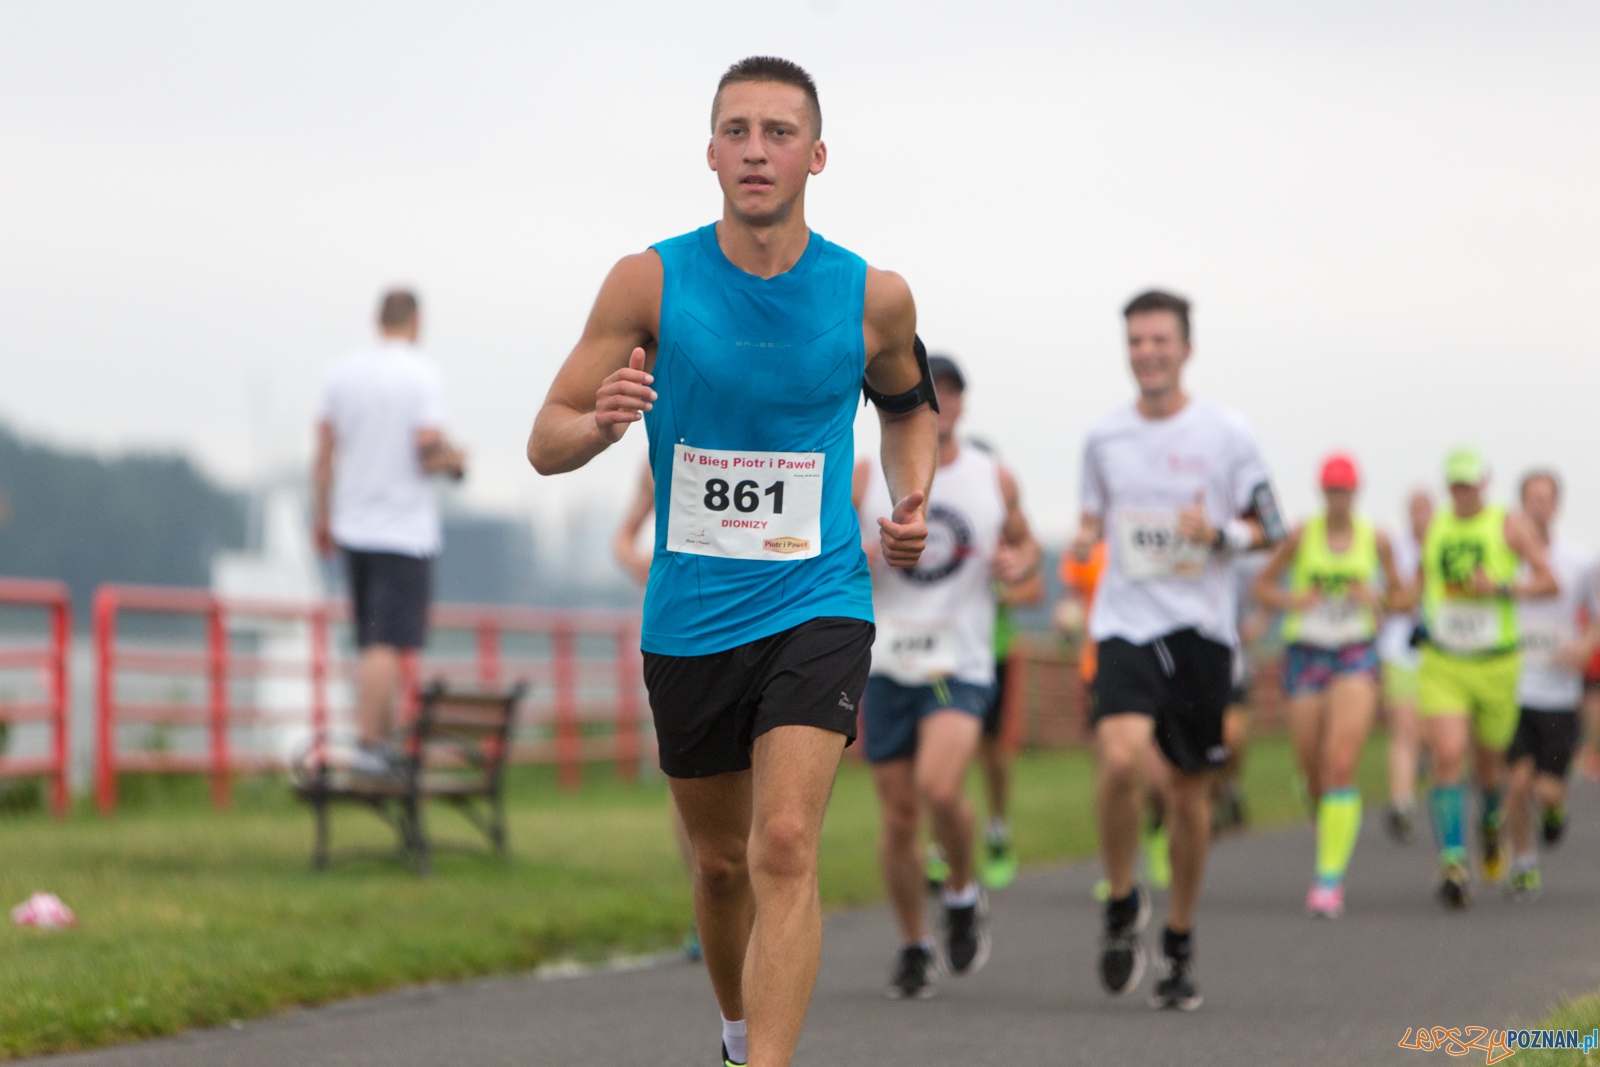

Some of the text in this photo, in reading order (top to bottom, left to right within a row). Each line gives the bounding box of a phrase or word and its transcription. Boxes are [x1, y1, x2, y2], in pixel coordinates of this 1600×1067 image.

[683, 452, 696, 463] IV
[699, 455, 728, 469] Bieg
[733, 457, 765, 468] Piotr
[777, 459, 816, 469] Paweł
[703, 478, 785, 514] 861
[721, 519, 768, 530] DIONIZY
[764, 540, 782, 548] Piotr
